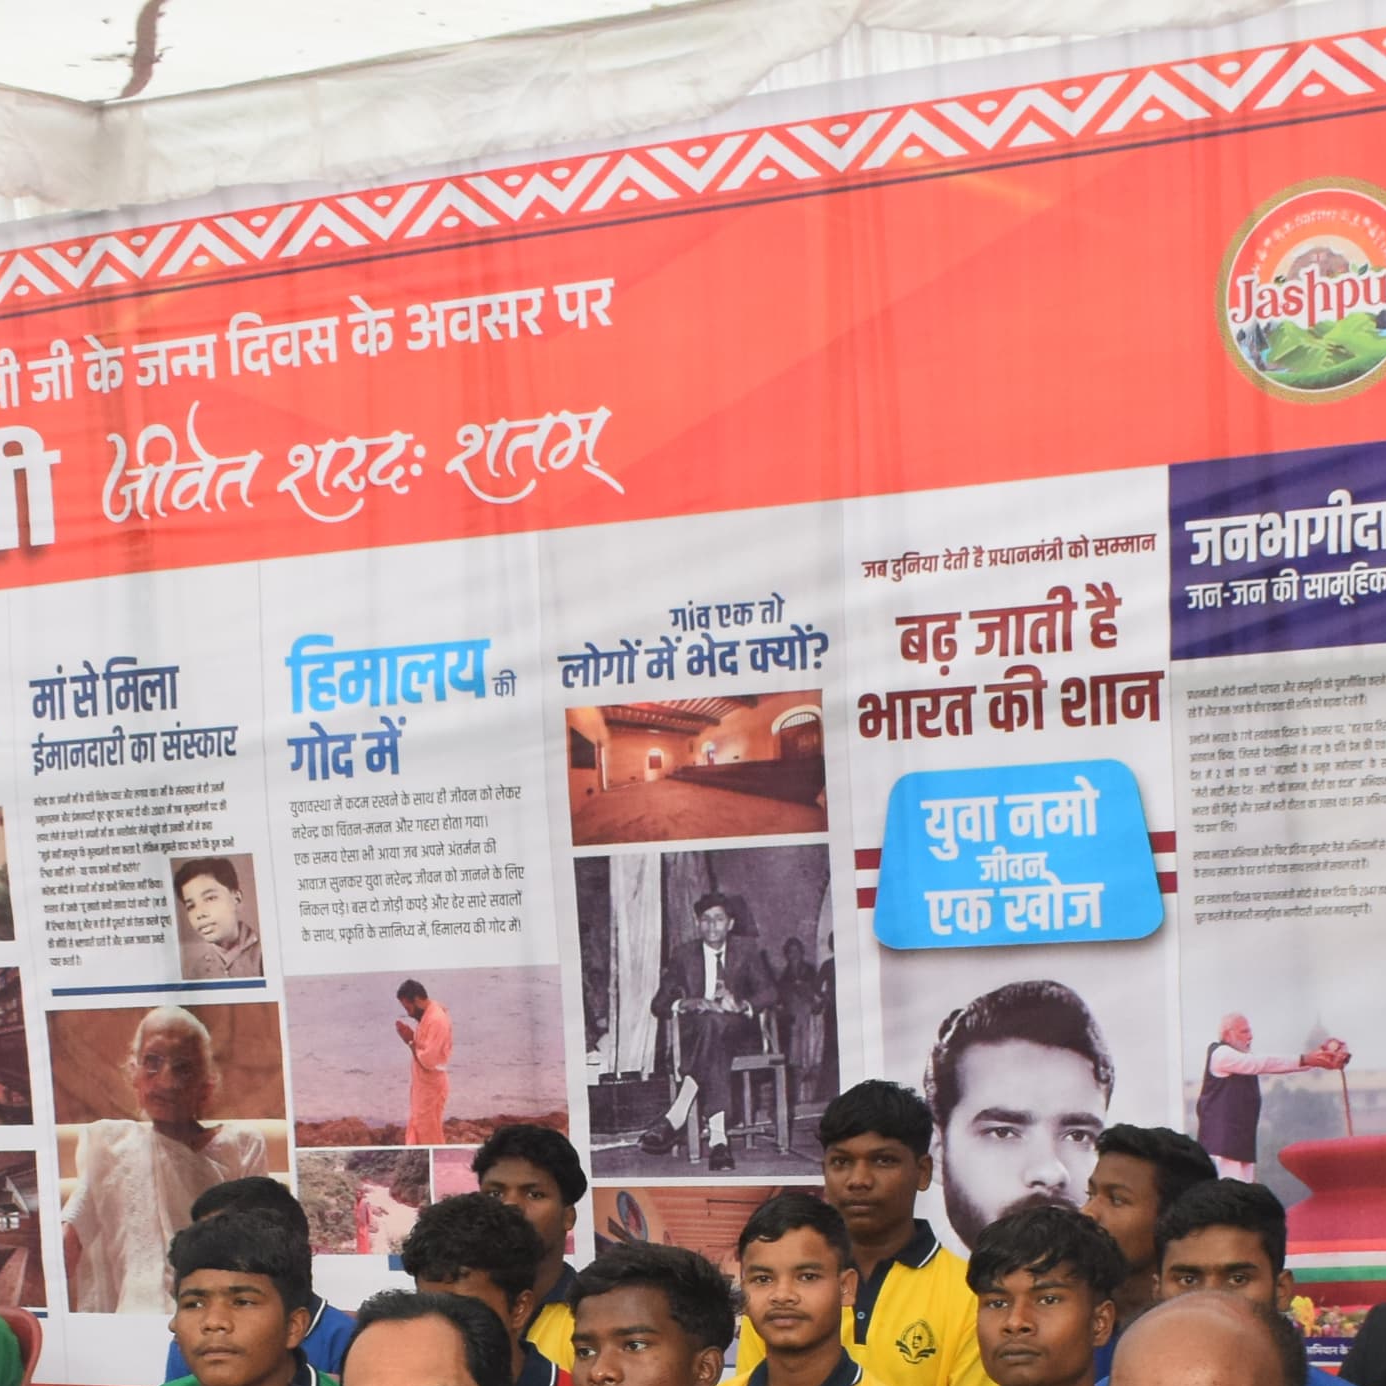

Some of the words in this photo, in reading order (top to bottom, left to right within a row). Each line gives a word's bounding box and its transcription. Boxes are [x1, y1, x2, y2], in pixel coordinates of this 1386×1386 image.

[27, 338, 75, 402] जी
[82, 334, 125, 394] के
[130, 333, 218, 386] जन्म
[224, 312, 340, 376] दिवस
[347, 297, 395, 357] के
[406, 287, 545, 350] अवसर
[553, 278, 615, 329] पर
[861, 559, 889, 578] जब
[890, 551, 940, 580] दुनिया
[942, 546, 970, 571] देती
[972, 545, 985, 568] है
[987, 536, 1064, 567] प्रधानमंत्री
[1066, 534, 1090, 559] को
[1092, 533, 1157, 557] सम्मान
[1185, 579, 1268, 610] जन-जन
[1271, 568, 1300, 602] की
[669, 600, 712, 632] गांव
[714, 602, 755, 628] एक
[758, 592, 785, 624] तो
[895, 612, 962, 677] बढ़
[969, 585, 1078, 657] जाती
[1085, 581, 1122, 649] है
[29, 665, 67, 721] मां
[69, 660, 100, 718] से
[102, 656, 180, 715] मिला
[285, 634, 491, 714] हिमालय
[491, 669, 517, 697] की
[557, 639, 642, 689] लोगों
[644, 636, 682, 681] में
[687, 632, 740, 678] भेद
[745, 624, 829, 673] क्यों?
[857, 685, 977, 741] भारत
[984, 665, 1048, 732] की
[1060, 670, 1165, 727] शान
[31, 727, 126, 776] ईमानदारी
[128, 732, 157, 763] का
[160, 726, 239, 761] संस्कार
[287, 721, 357, 781] गोद
[361, 716, 406, 775] में
[920, 796, 999, 861] युवा
[1004, 775, 1100, 839] नमो
[975, 848, 1049, 884] जीवन
[924, 888, 994, 936] एक
[999, 878, 1104, 932] खोज
